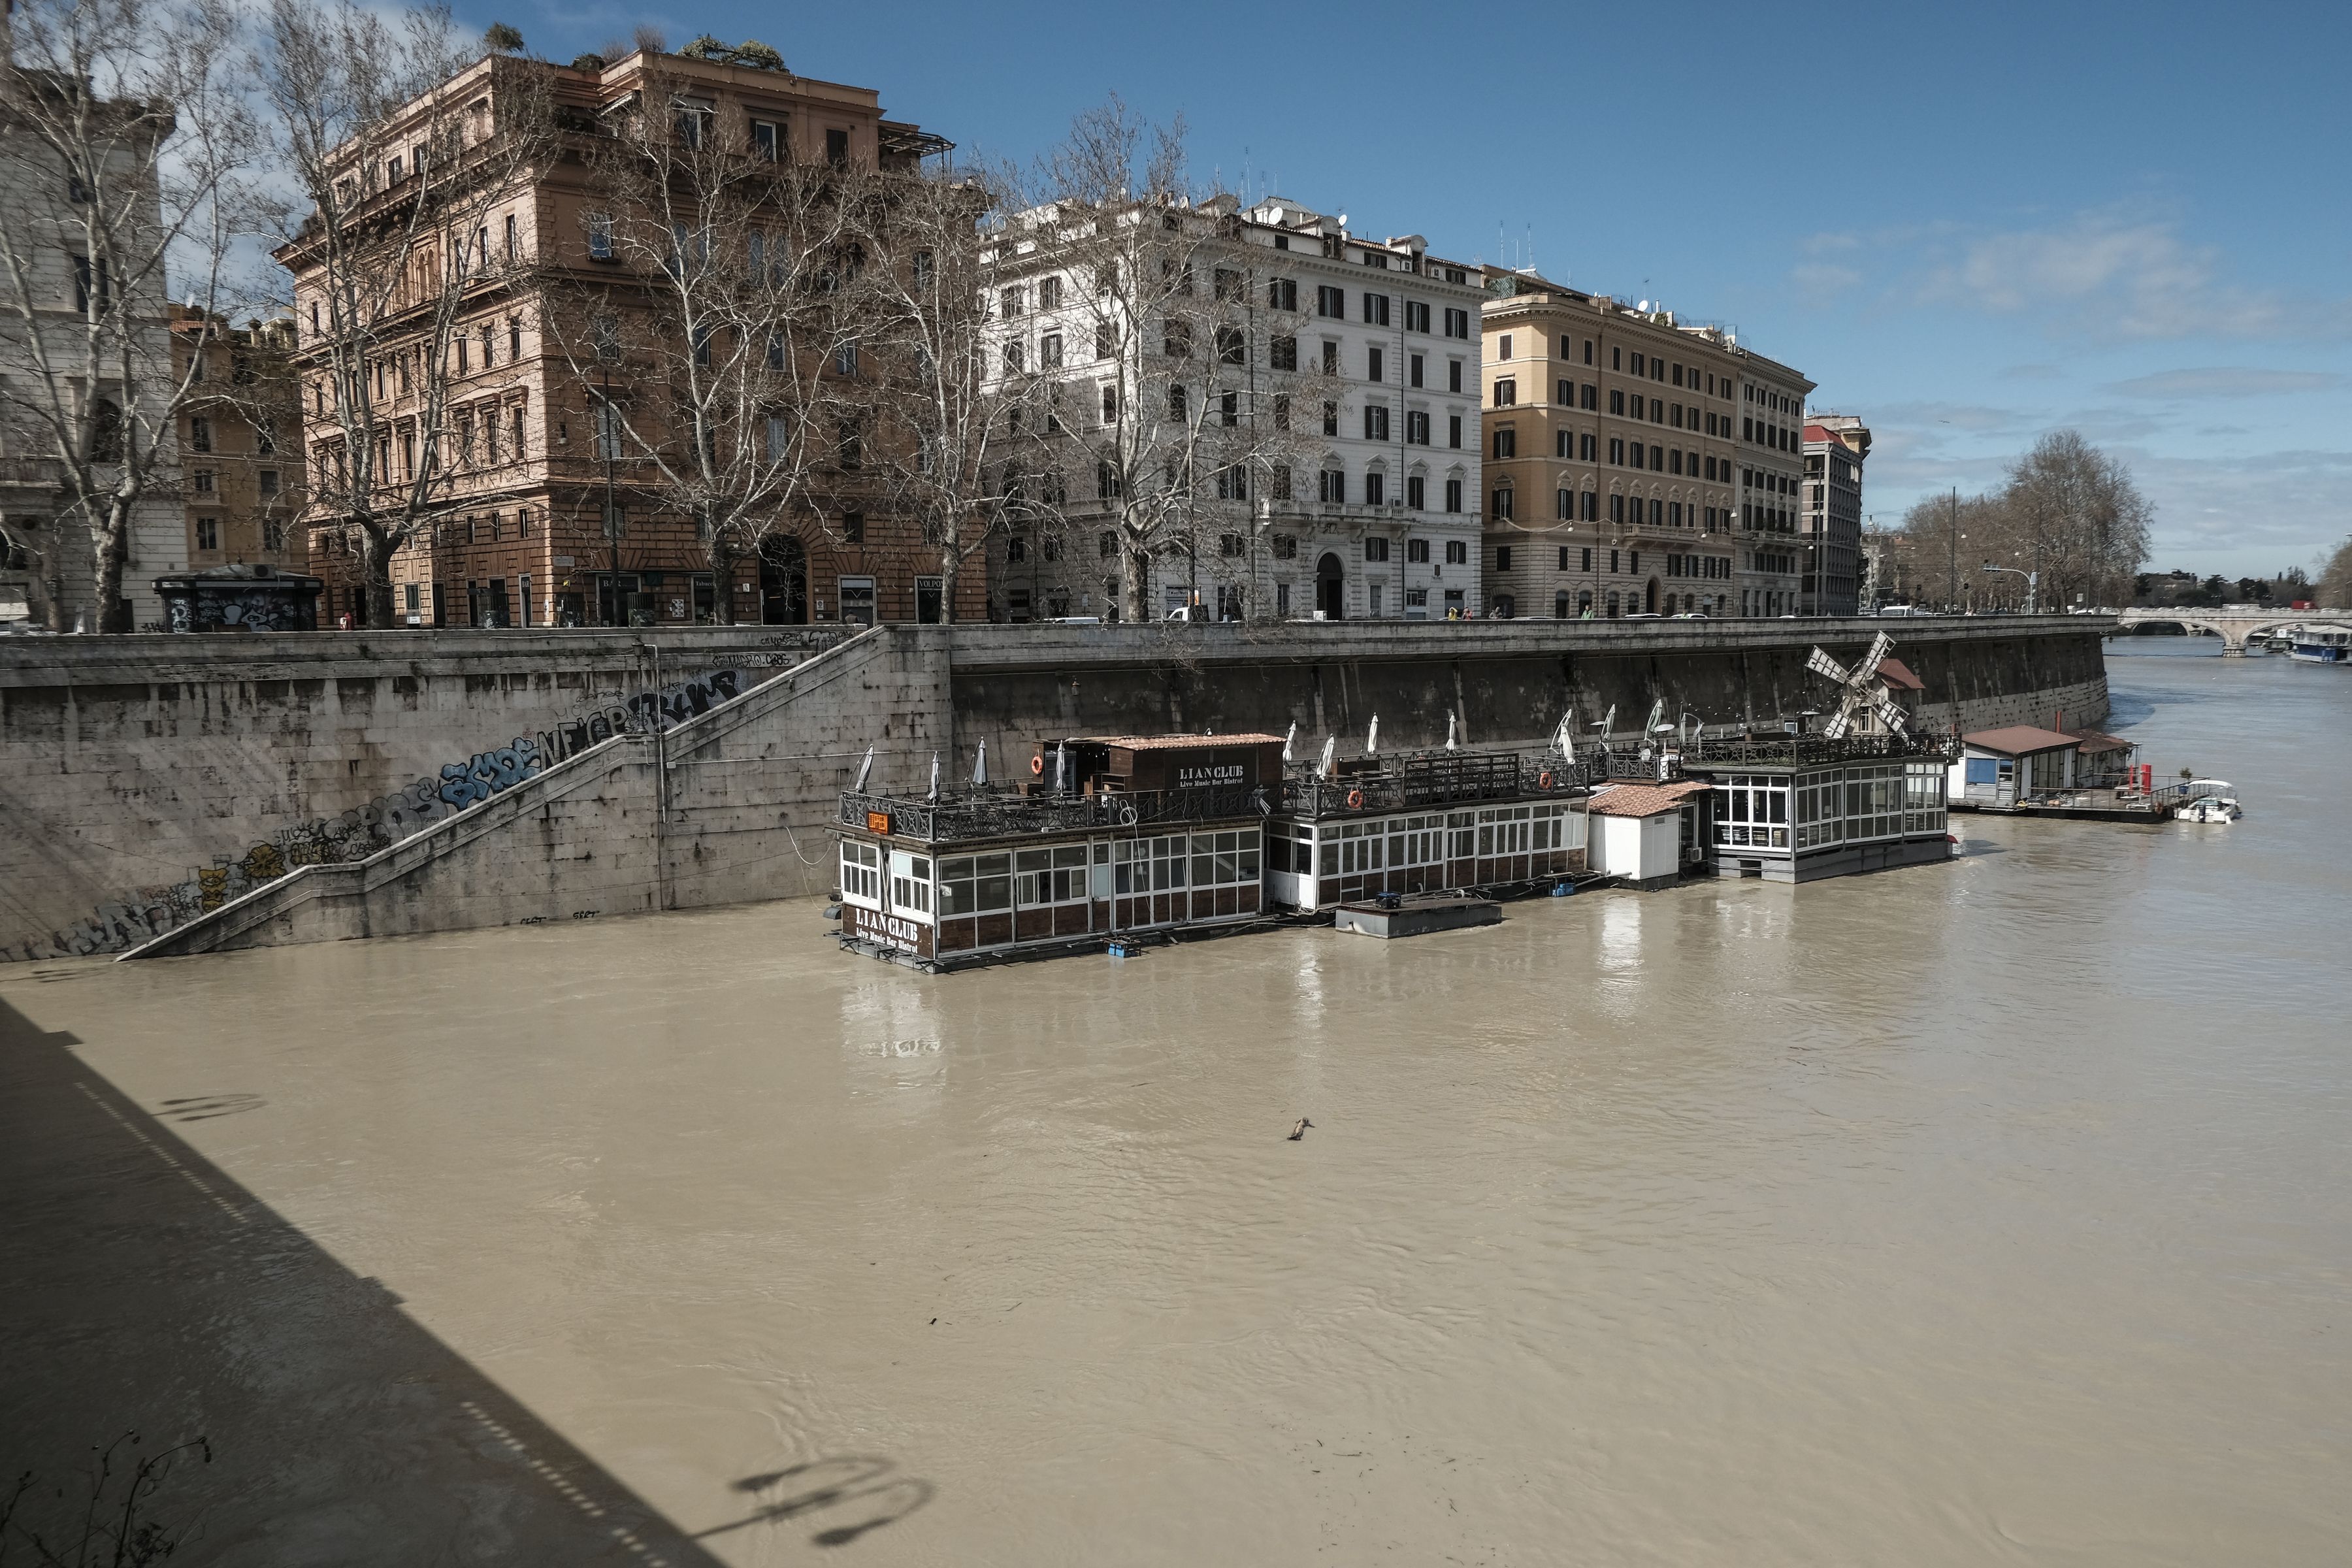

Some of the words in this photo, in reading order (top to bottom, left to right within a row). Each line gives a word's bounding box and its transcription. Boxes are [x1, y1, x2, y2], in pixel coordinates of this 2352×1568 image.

[856, 927, 869, 939] Live
[870, 930, 886, 944] Music
[887, 936, 897, 947] Bar
[898, 939, 918, 954] Bistrot
